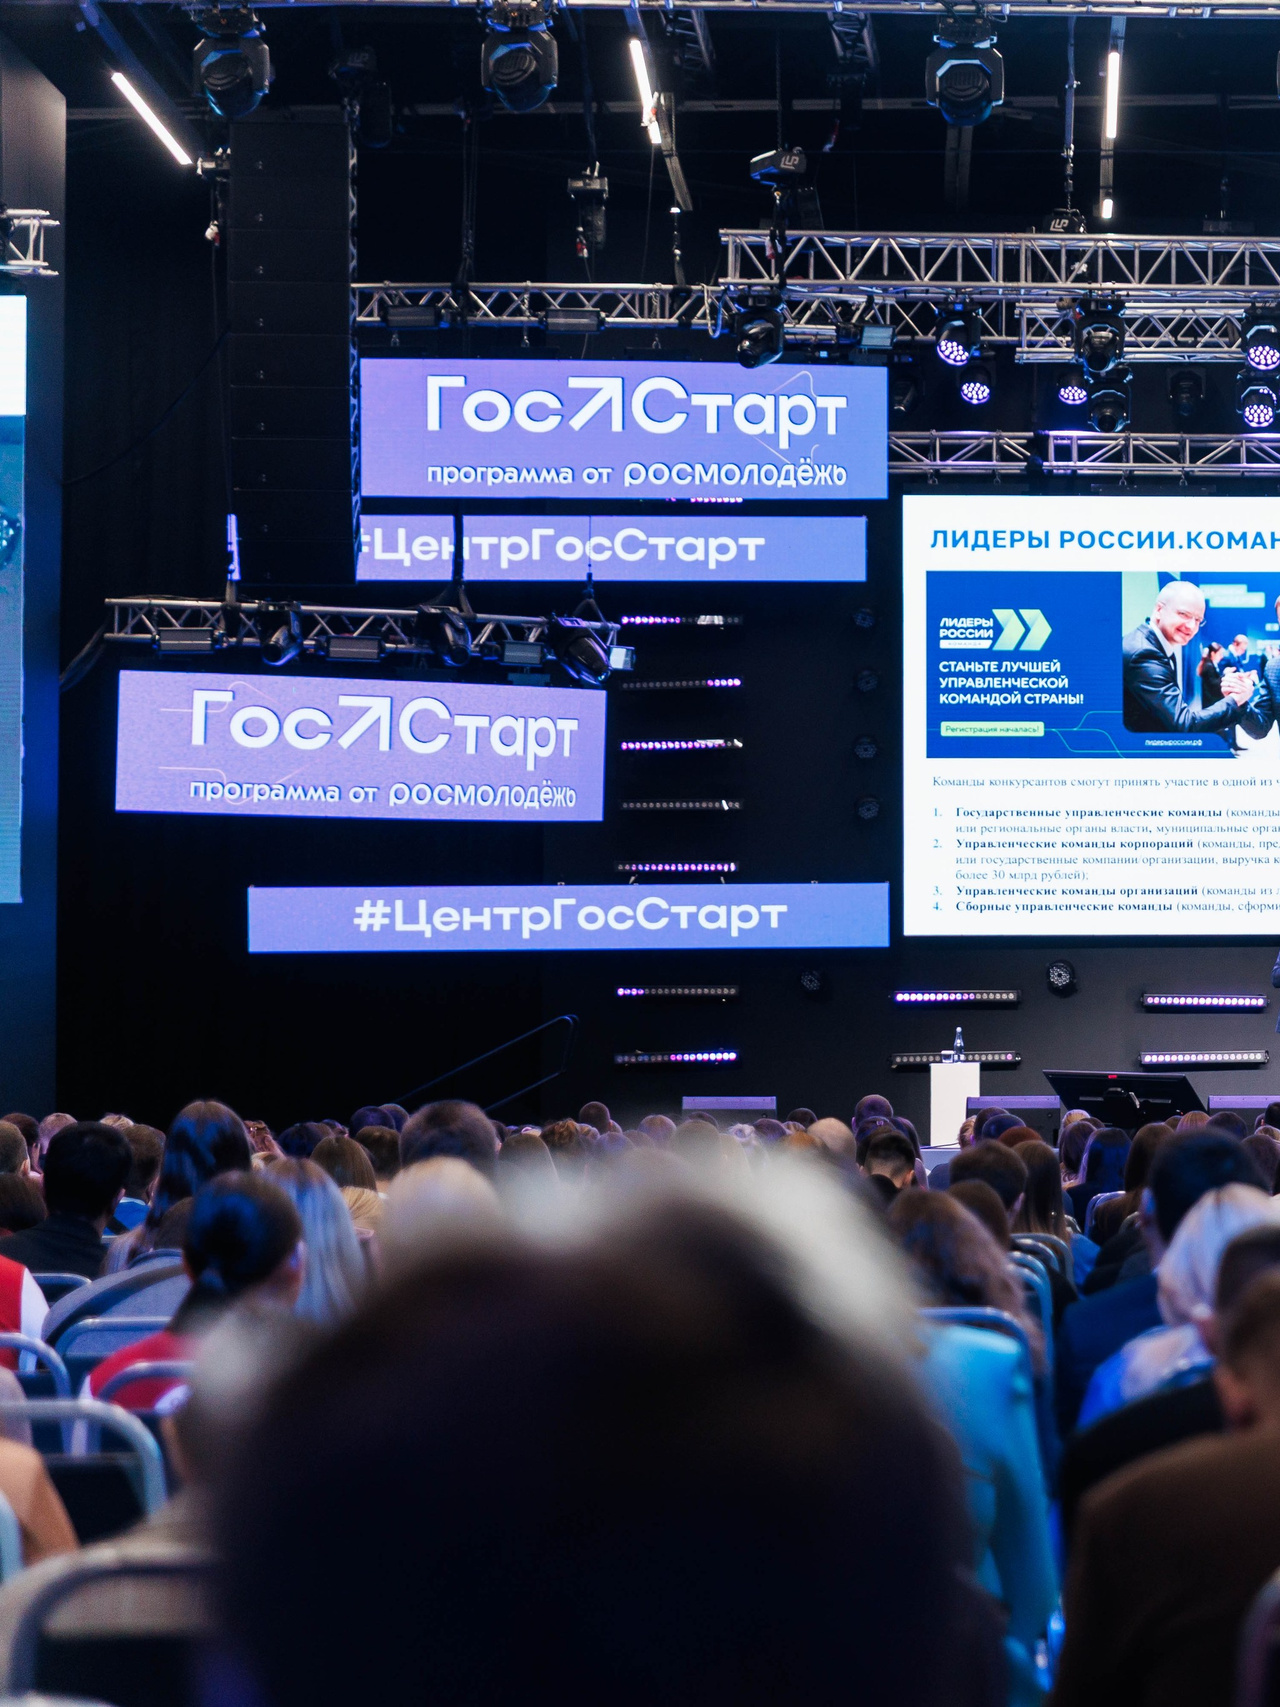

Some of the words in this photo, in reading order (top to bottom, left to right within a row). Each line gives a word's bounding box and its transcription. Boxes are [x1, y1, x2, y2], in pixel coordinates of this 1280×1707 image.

[427, 464, 573, 486] программа
[582, 466, 613, 484] от
[623, 458, 848, 488] росмолодёжь
[930, 529, 1050, 552] ЛИДЕРЫ
[940, 617, 993, 628] ЛИДЕРЫ
[940, 628, 993, 638] РОССИИ
[939, 661, 998, 673] СТАНЬТЕ
[1000, 660, 1061, 673] ЛУЧШЕЙ
[939, 676, 1069, 689] УПРАВЛЕНЧЕСКОЙ
[939, 692, 1021, 706] КОМАНДОЙ
[1024, 693, 1084, 705] СТРАНЫ!
[945, 725, 996, 734] Регистрация
[1000, 725, 1040, 734] началась!
[932, 776, 985, 787] Команды
[989, 779, 1067, 789] конкурсантов
[1070, 779, 1110, 789] смогут
[1114, 779, 1161, 788] принять
[1164, 779, 1209, 788] участие
[1222, 776, 1257, 788] одной
[1260, 779, 1273, 787] из
[190, 779, 340, 803] программа
[349, 784, 378, 803] от
[389, 780, 577, 810] росмолодёжь
[933, 807, 943, 817] 1.
[956, 807, 1061, 820] Государственные
[1065, 809, 1164, 820] управленческие
[1168, 809, 1222, 819] команды
[955, 825, 977, 833] или
[980, 825, 1062, 836] региональные
[1065, 825, 1107, 836] органы
[1111, 825, 1152, 835] власти,
[1156, 825, 1249, 836] муниципальные
[933, 838, 943, 849] 2.
[956, 838, 1058, 851] Управленческие
[1061, 840, 1116, 850] команды
[1120, 838, 1193, 851] корпораций
[1197, 839, 1255, 850] (команды,
[955, 857, 977, 865] или
[980, 857, 1079, 867] государственные
[1222, 856, 1271, 867] выручка
[955, 869, 989, 880] более
[992, 869, 1006, 880] 30
[1009, 872, 1038, 882] млрд
[1041, 869, 1089, 883] рублей);
[933, 885, 943, 896] 3.
[956, 885, 1058, 898] Управленческие
[1061, 888, 1116, 897] команды
[1120, 885, 1198, 898] организаций
[1201, 886, 1256, 897] (команды
[933, 901, 943, 911] 4.
[956, 901, 1011, 913] Сборные
[1015, 903, 1114, 914] управленческие
[1118, 903, 1173, 913] команды
[1176, 902, 1234, 913] (команды,
[353, 897, 789, 938] #ЦентрГосСтарт
